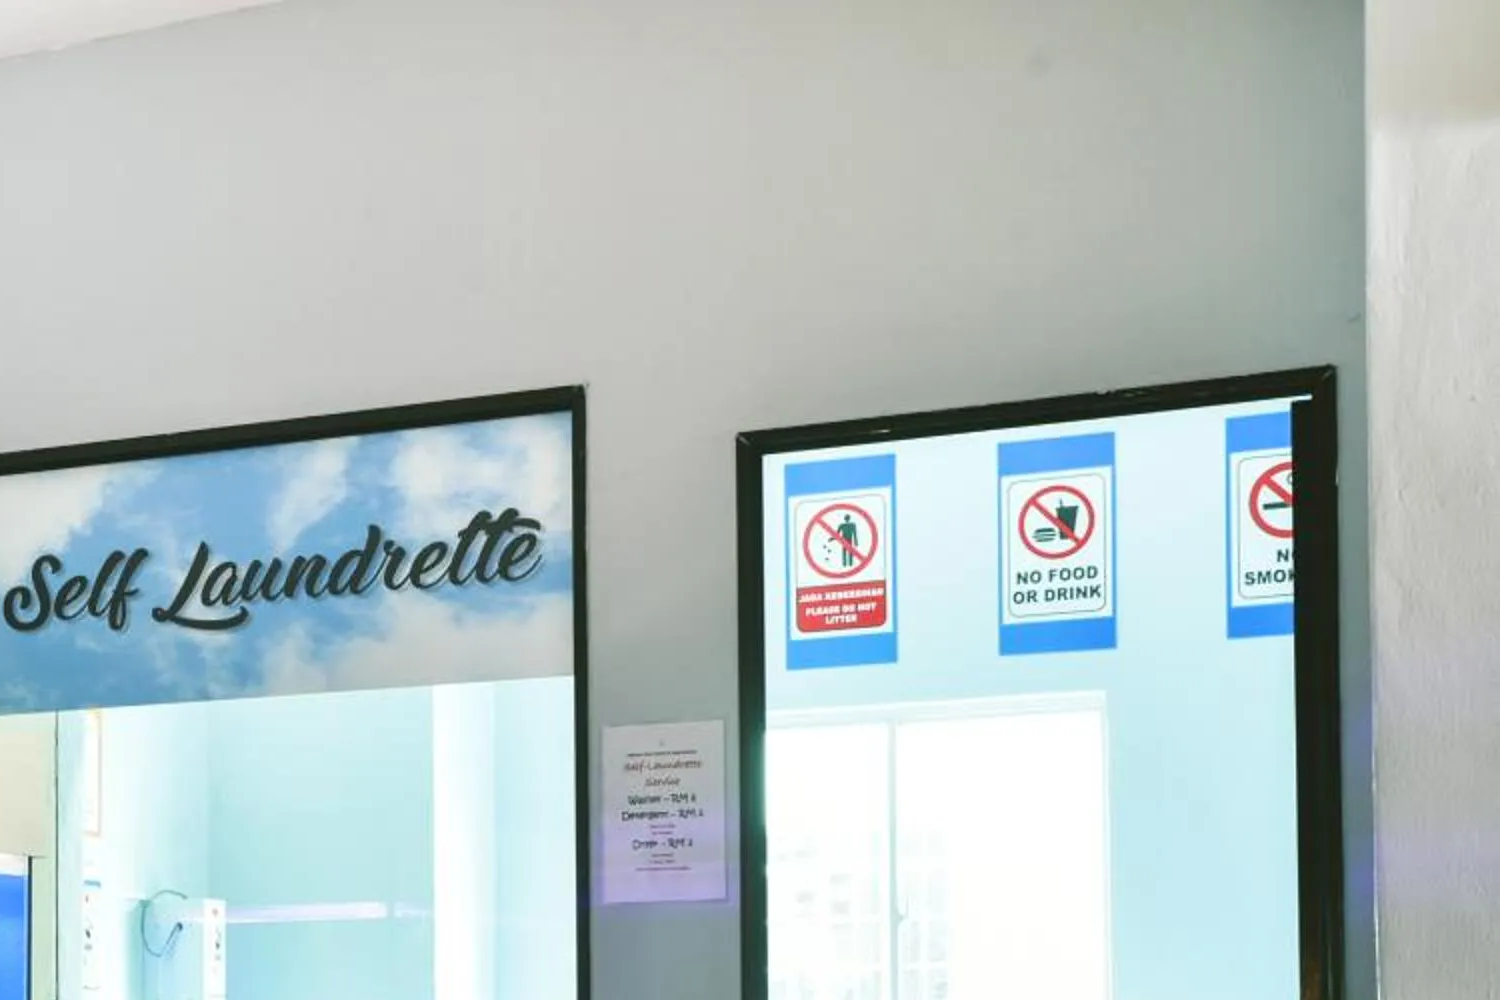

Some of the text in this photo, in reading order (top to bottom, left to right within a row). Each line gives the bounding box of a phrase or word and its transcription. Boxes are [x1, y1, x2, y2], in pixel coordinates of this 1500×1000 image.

[1277, 549, 1294, 562] N
[3, 507, 543, 632] Self Laundrette
[1016, 565, 1098, 585] NO FOOD
[1012, 584, 1102, 605] OR DRINK
[805, 602, 877, 616] PLEASE DO NOT
[825, 613, 857, 625] LITTER
